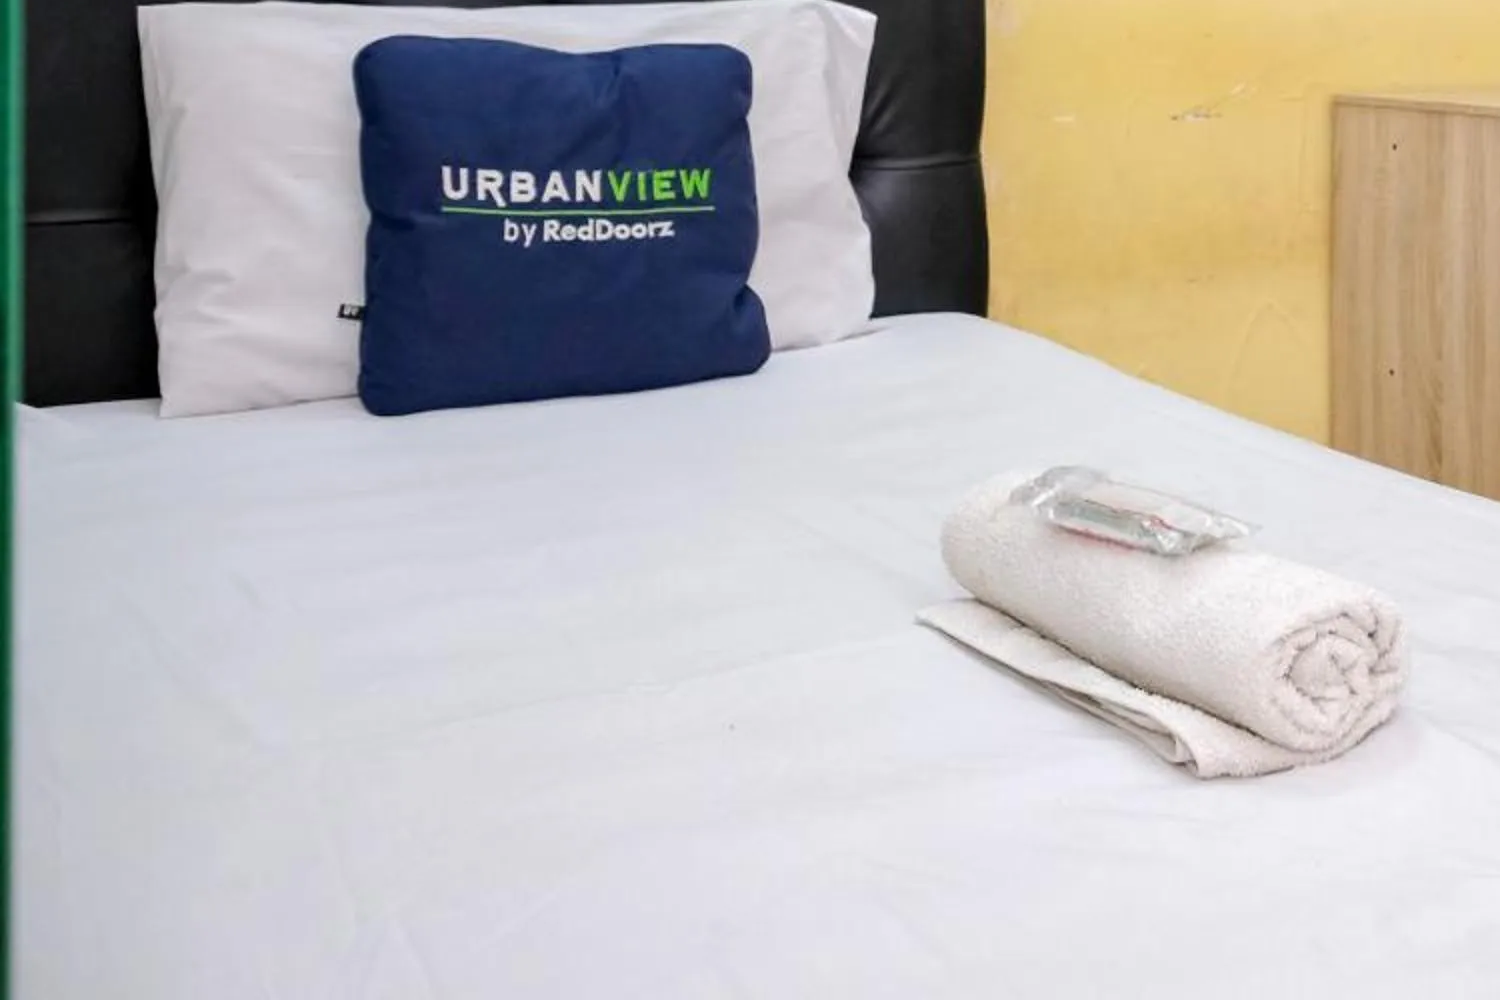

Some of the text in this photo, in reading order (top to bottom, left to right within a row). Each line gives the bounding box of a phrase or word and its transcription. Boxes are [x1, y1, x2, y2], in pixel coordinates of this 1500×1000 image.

[441, 165, 711, 207] URBANVIEW
[503, 217, 675, 248] by RedDoorz
